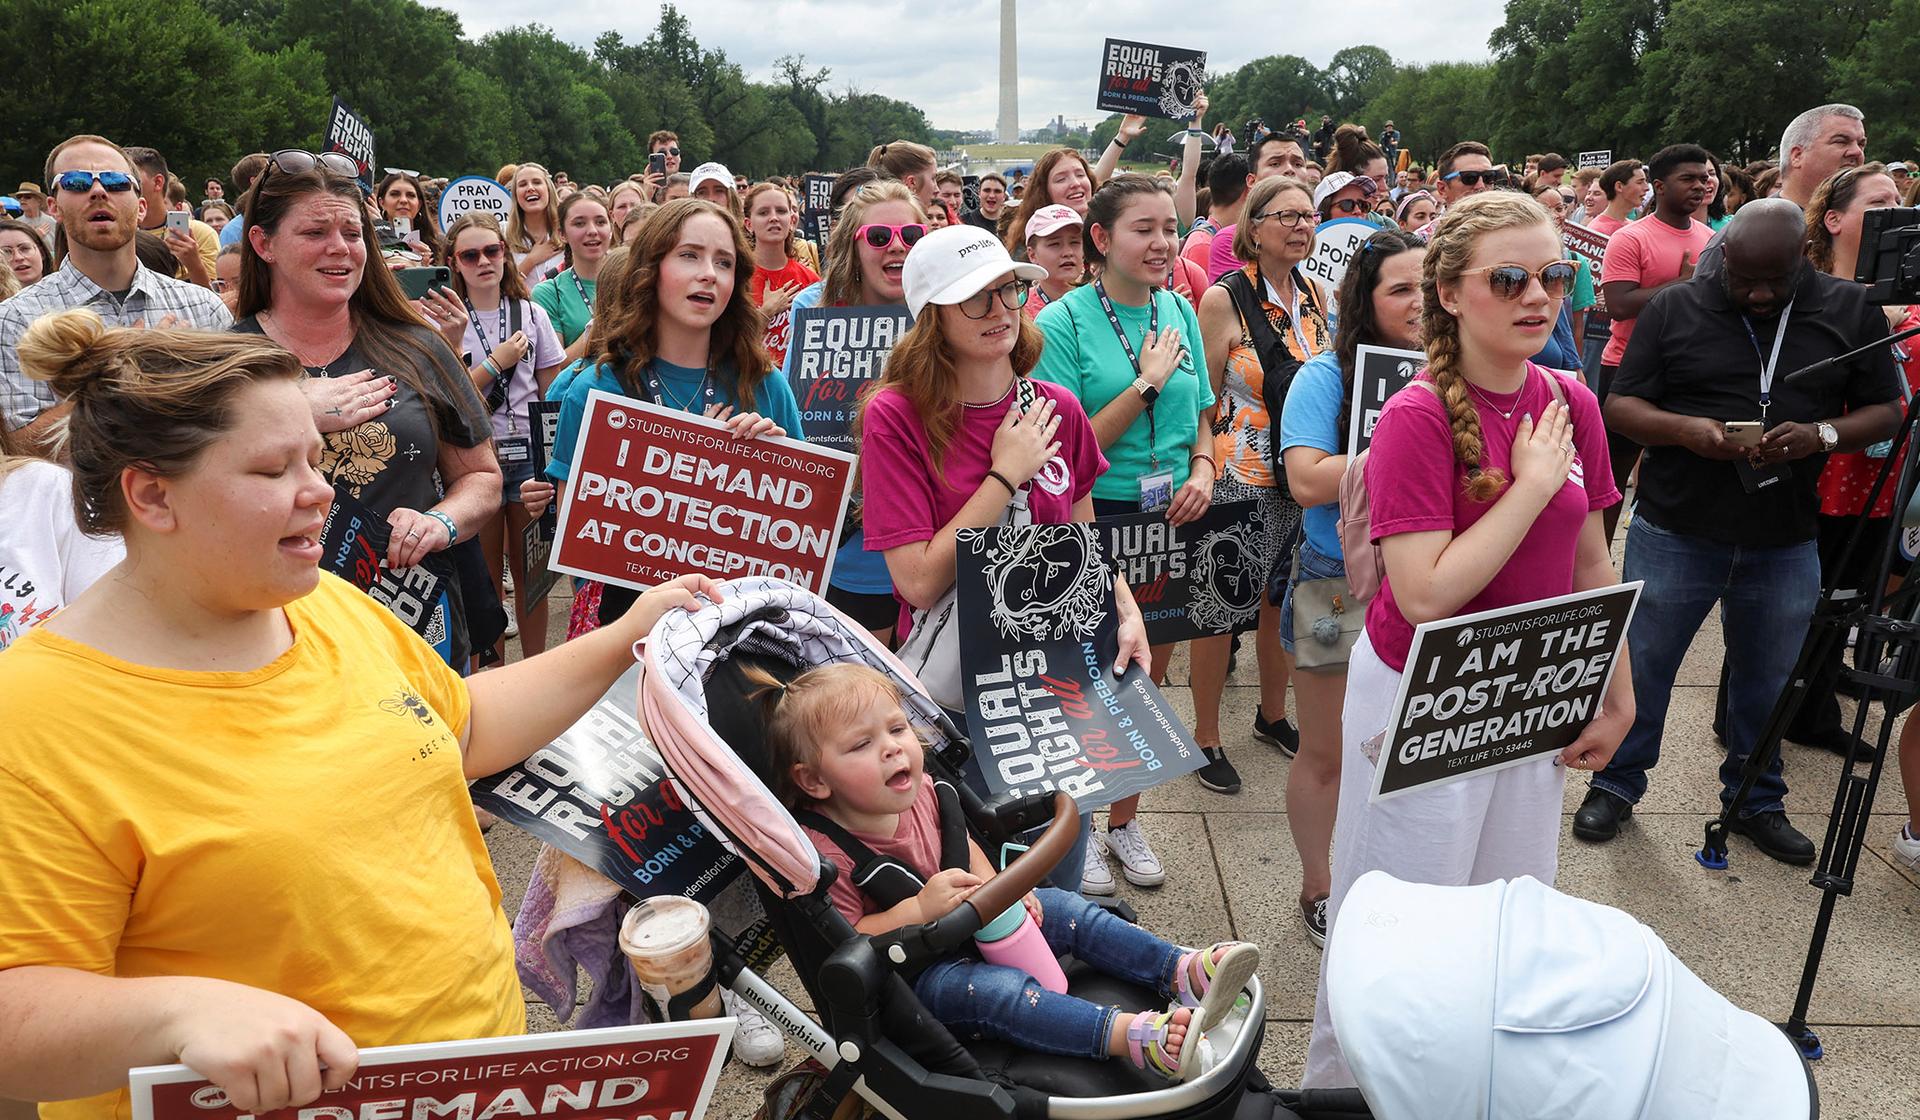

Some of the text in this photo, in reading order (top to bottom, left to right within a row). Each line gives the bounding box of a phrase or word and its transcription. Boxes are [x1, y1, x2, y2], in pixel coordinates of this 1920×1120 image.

[1106, 60, 1163, 82] RIGHTS
[1108, 44, 1163, 67] EQUAL
[1102, 90, 1121, 99] BORN
[1128, 94, 1158, 104] PREBORN
[1131, 75, 1153, 92] all
[330, 123, 374, 172] RIGHTS
[452, 198, 503, 210] TO END
[458, 185, 491, 196] PRAY
[810, 195, 831, 210] RIG
[958, 239, 996, 258] pro-life
[1561, 233, 1606, 258] EMAND
[1306, 256, 1335, 282] DEL
[800, 349, 890, 380] RIGHT
[804, 370, 849, 411] for
[835, 410, 845, 421] &
[805, 434, 854, 443] dentsforLife
[615, 438, 631, 468] I
[642, 445, 813, 510] DEMAND
[577, 471, 831, 558] PROTECTION
[335, 516, 362, 568] BORN
[576, 518, 621, 546] AT
[623, 529, 814, 590] CONCEPTION
[1112, 522, 1187, 557] UAL
[625, 561, 680, 581] TEXT ACT
[1144, 608, 1185, 622] EBORN
[1474, 604, 1604, 641] STUDENTSFORLIFE.ORG
[1426, 619, 1611, 684] I AM THE
[1081, 642, 1163, 772] BORN & PREBORN
[1402, 652, 1613, 730] POST-ROE
[1013, 649, 1106, 799] RIGHTS
[1038, 674, 1143, 772] for all
[1131, 679, 1191, 759] StudentsforLife.org
[1398, 695, 1592, 765] GENERATION
[1447, 739, 1533, 769] TEXT LIFE TO 53445
[540, 738, 665, 842] RIGHT
[600, 799, 665, 865] for
[633, 834, 696, 885] BORN &
[682, 854, 738, 899] dentsforLife.
[744, 986, 827, 1053] mockingbird
[324, 1047, 690, 1093] NTSFORLIFEACTION.ORG
